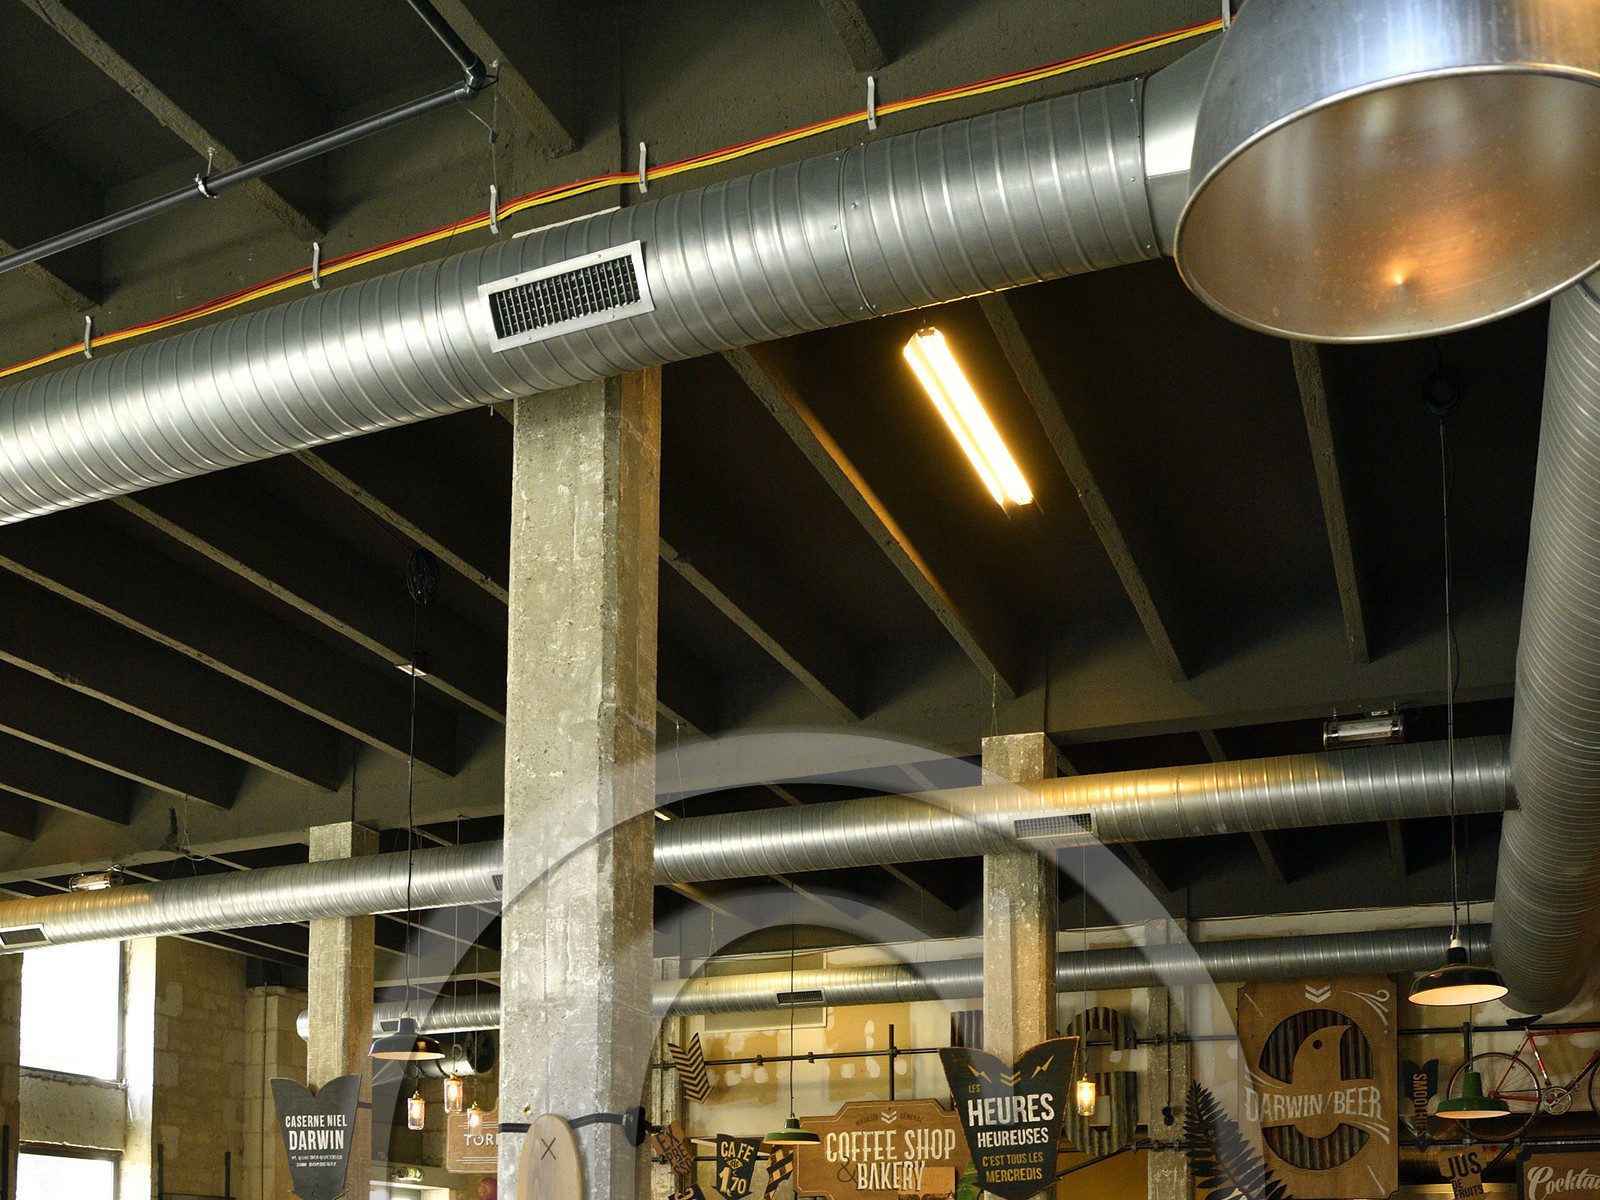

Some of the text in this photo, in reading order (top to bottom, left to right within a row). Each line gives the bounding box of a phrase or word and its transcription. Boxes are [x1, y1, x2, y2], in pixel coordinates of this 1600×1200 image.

[968, 1083, 981, 1094] LES
[967, 1093, 1055, 1127] HEURES
[285, 1114, 348, 1128] CASERNE NIEL
[288, 1130, 344, 1151] DARWIN
[826, 1128, 956, 1163] COFFEE SHOP
[977, 1127, 1049, 1148] HEUREUSES
[982, 1151, 1044, 1167] C'EST TOUS LES
[1447, 1151, 1482, 1180] JUS
[857, 1161, 926, 1191] BAKERY
[985, 1167, 1043, 1184] MERCREDIS
[1452, 1179, 1464, 1189] DE
[1453, 1184, 1484, 1200] FRUITS
